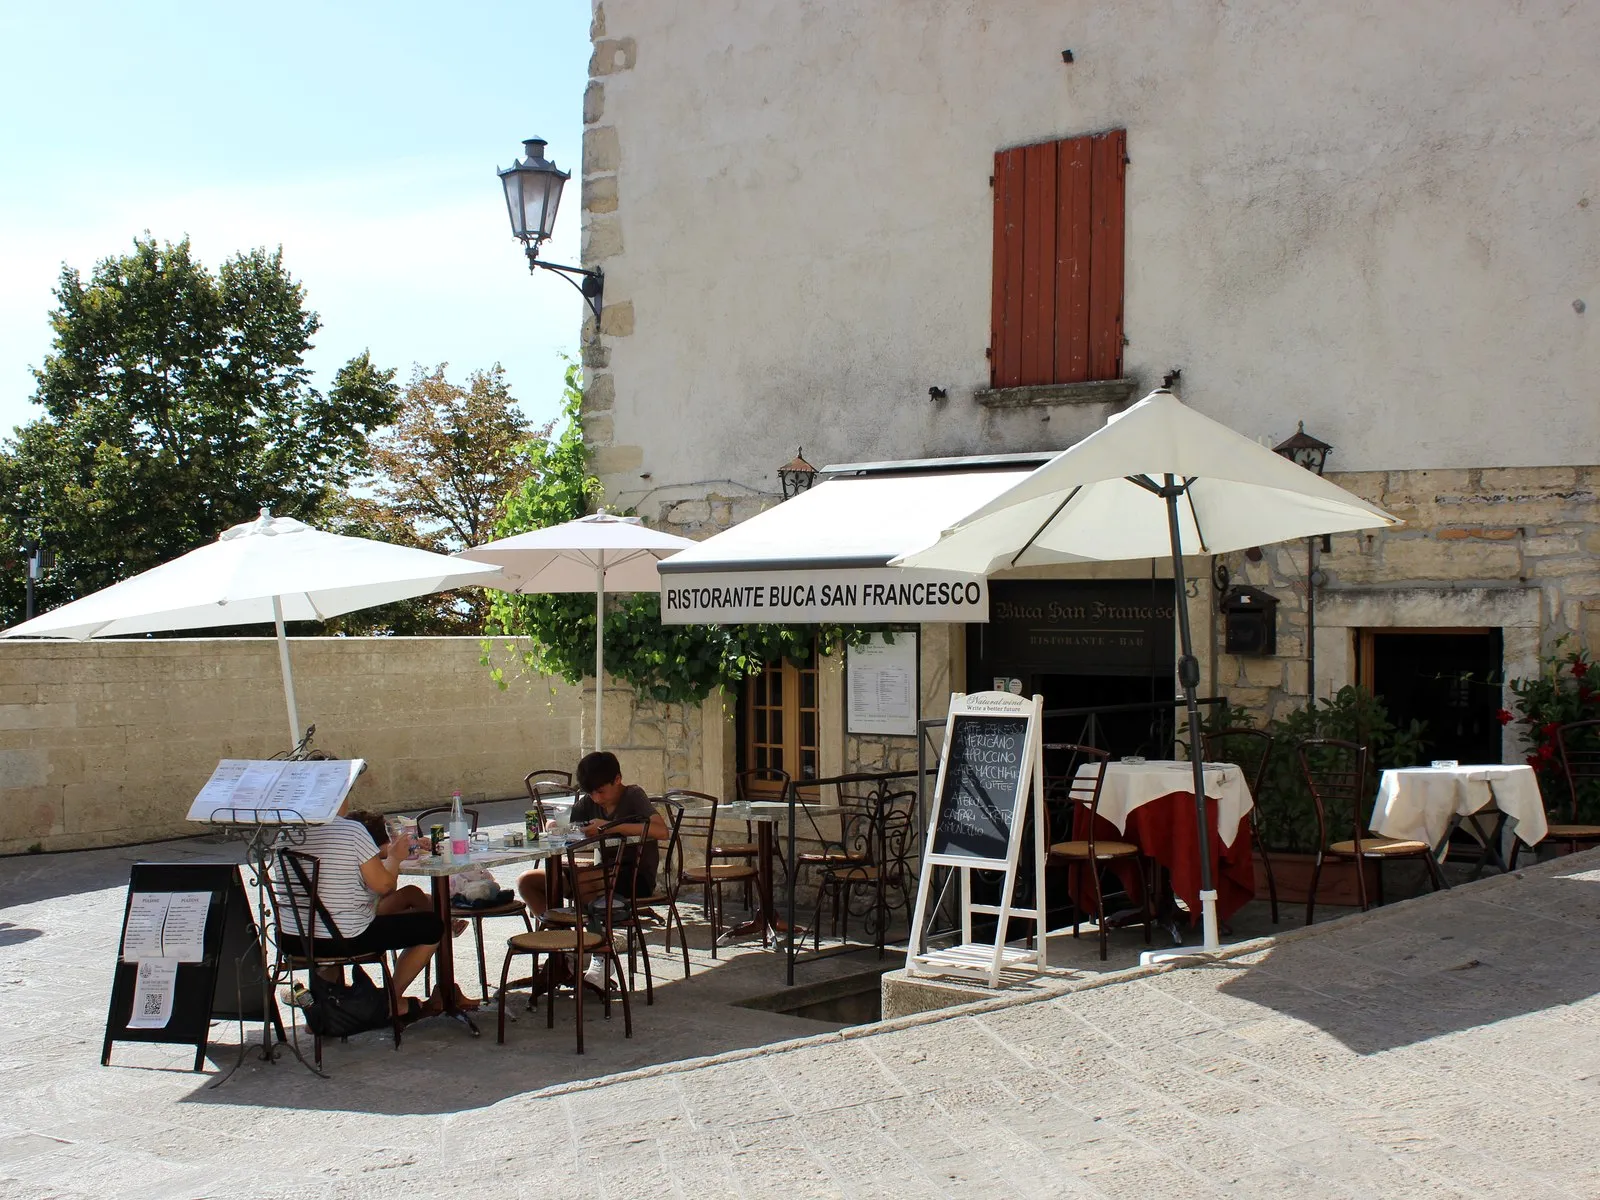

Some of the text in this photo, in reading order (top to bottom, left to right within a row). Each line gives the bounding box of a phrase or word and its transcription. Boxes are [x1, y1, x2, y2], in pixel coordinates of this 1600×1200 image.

[667, 581, 981, 610] RISTORANTE BUCA SAN FRANCESCO
[996, 600, 1175, 623] Buca San Francesc
[1030, 635, 1105, 646] RISTORANTE
[1119, 636, 1143, 647] BAR
[966, 694, 1025, 706] Natural wind
[952, 747, 1016, 763] CAPPUCCINO
